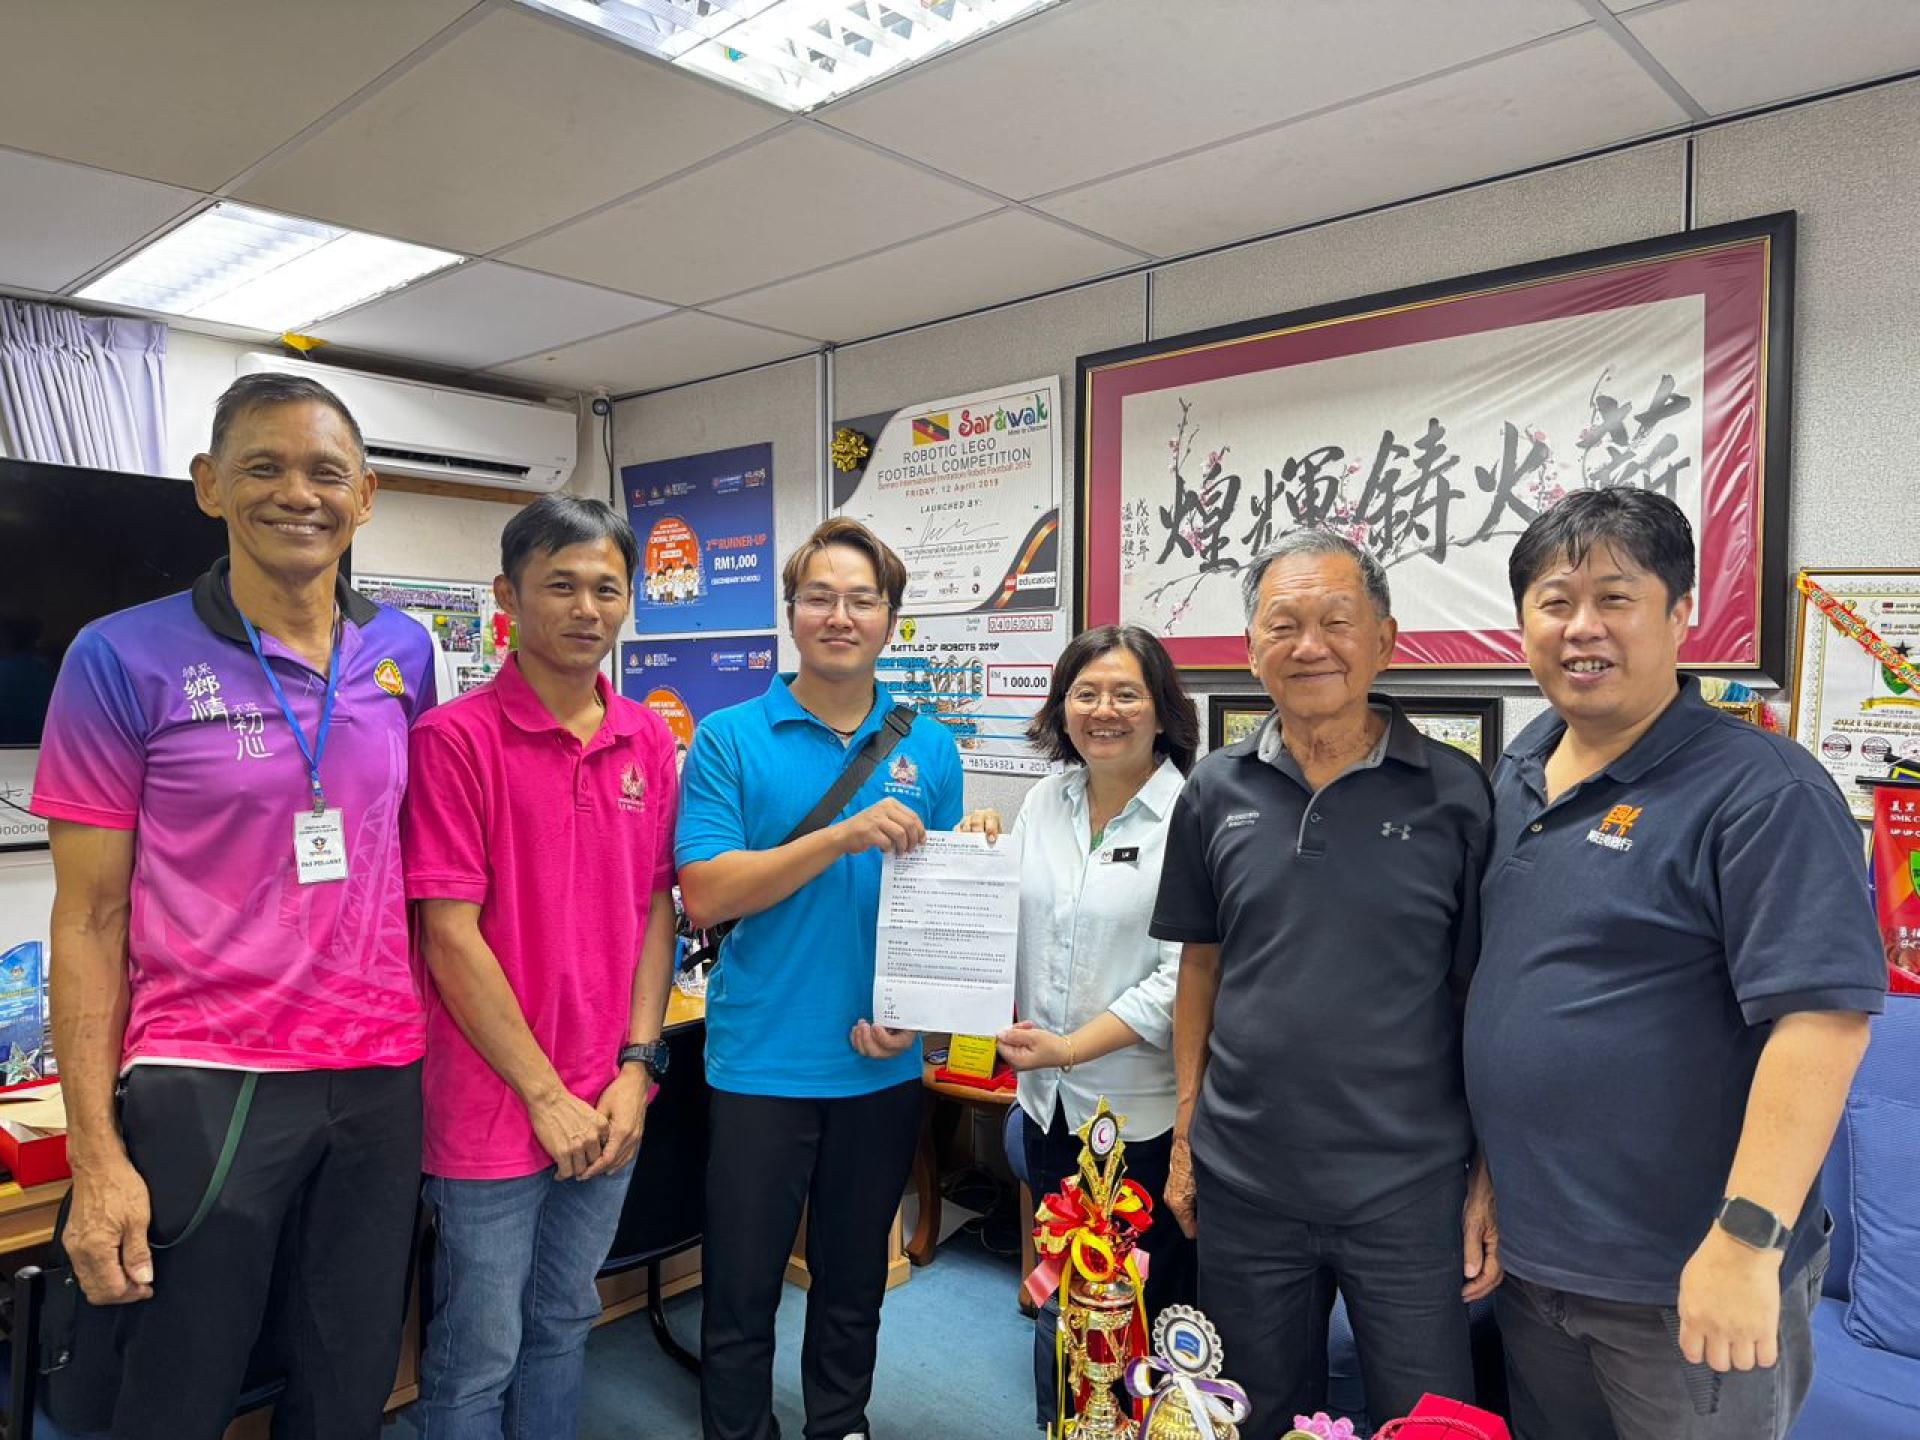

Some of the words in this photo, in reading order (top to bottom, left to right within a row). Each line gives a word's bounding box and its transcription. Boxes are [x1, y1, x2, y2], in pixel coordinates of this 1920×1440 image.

[958, 393, 1048, 437] Sarawak
[903, 443, 957, 464] ROBOTIC
[963, 437, 996, 455] LEGO
[877, 462, 938, 482] FOOTBALL
[942, 447, 1032, 473] COMPETITION
[920, 500, 965, 514] LAUNCHED
[714, 554, 758, 571] RM1,000
[1018, 576, 1057, 586] education
[890, 643, 925, 652] BATTLE
[927, 643, 938, 652] OF
[940, 643, 976, 652] ROBOTS
